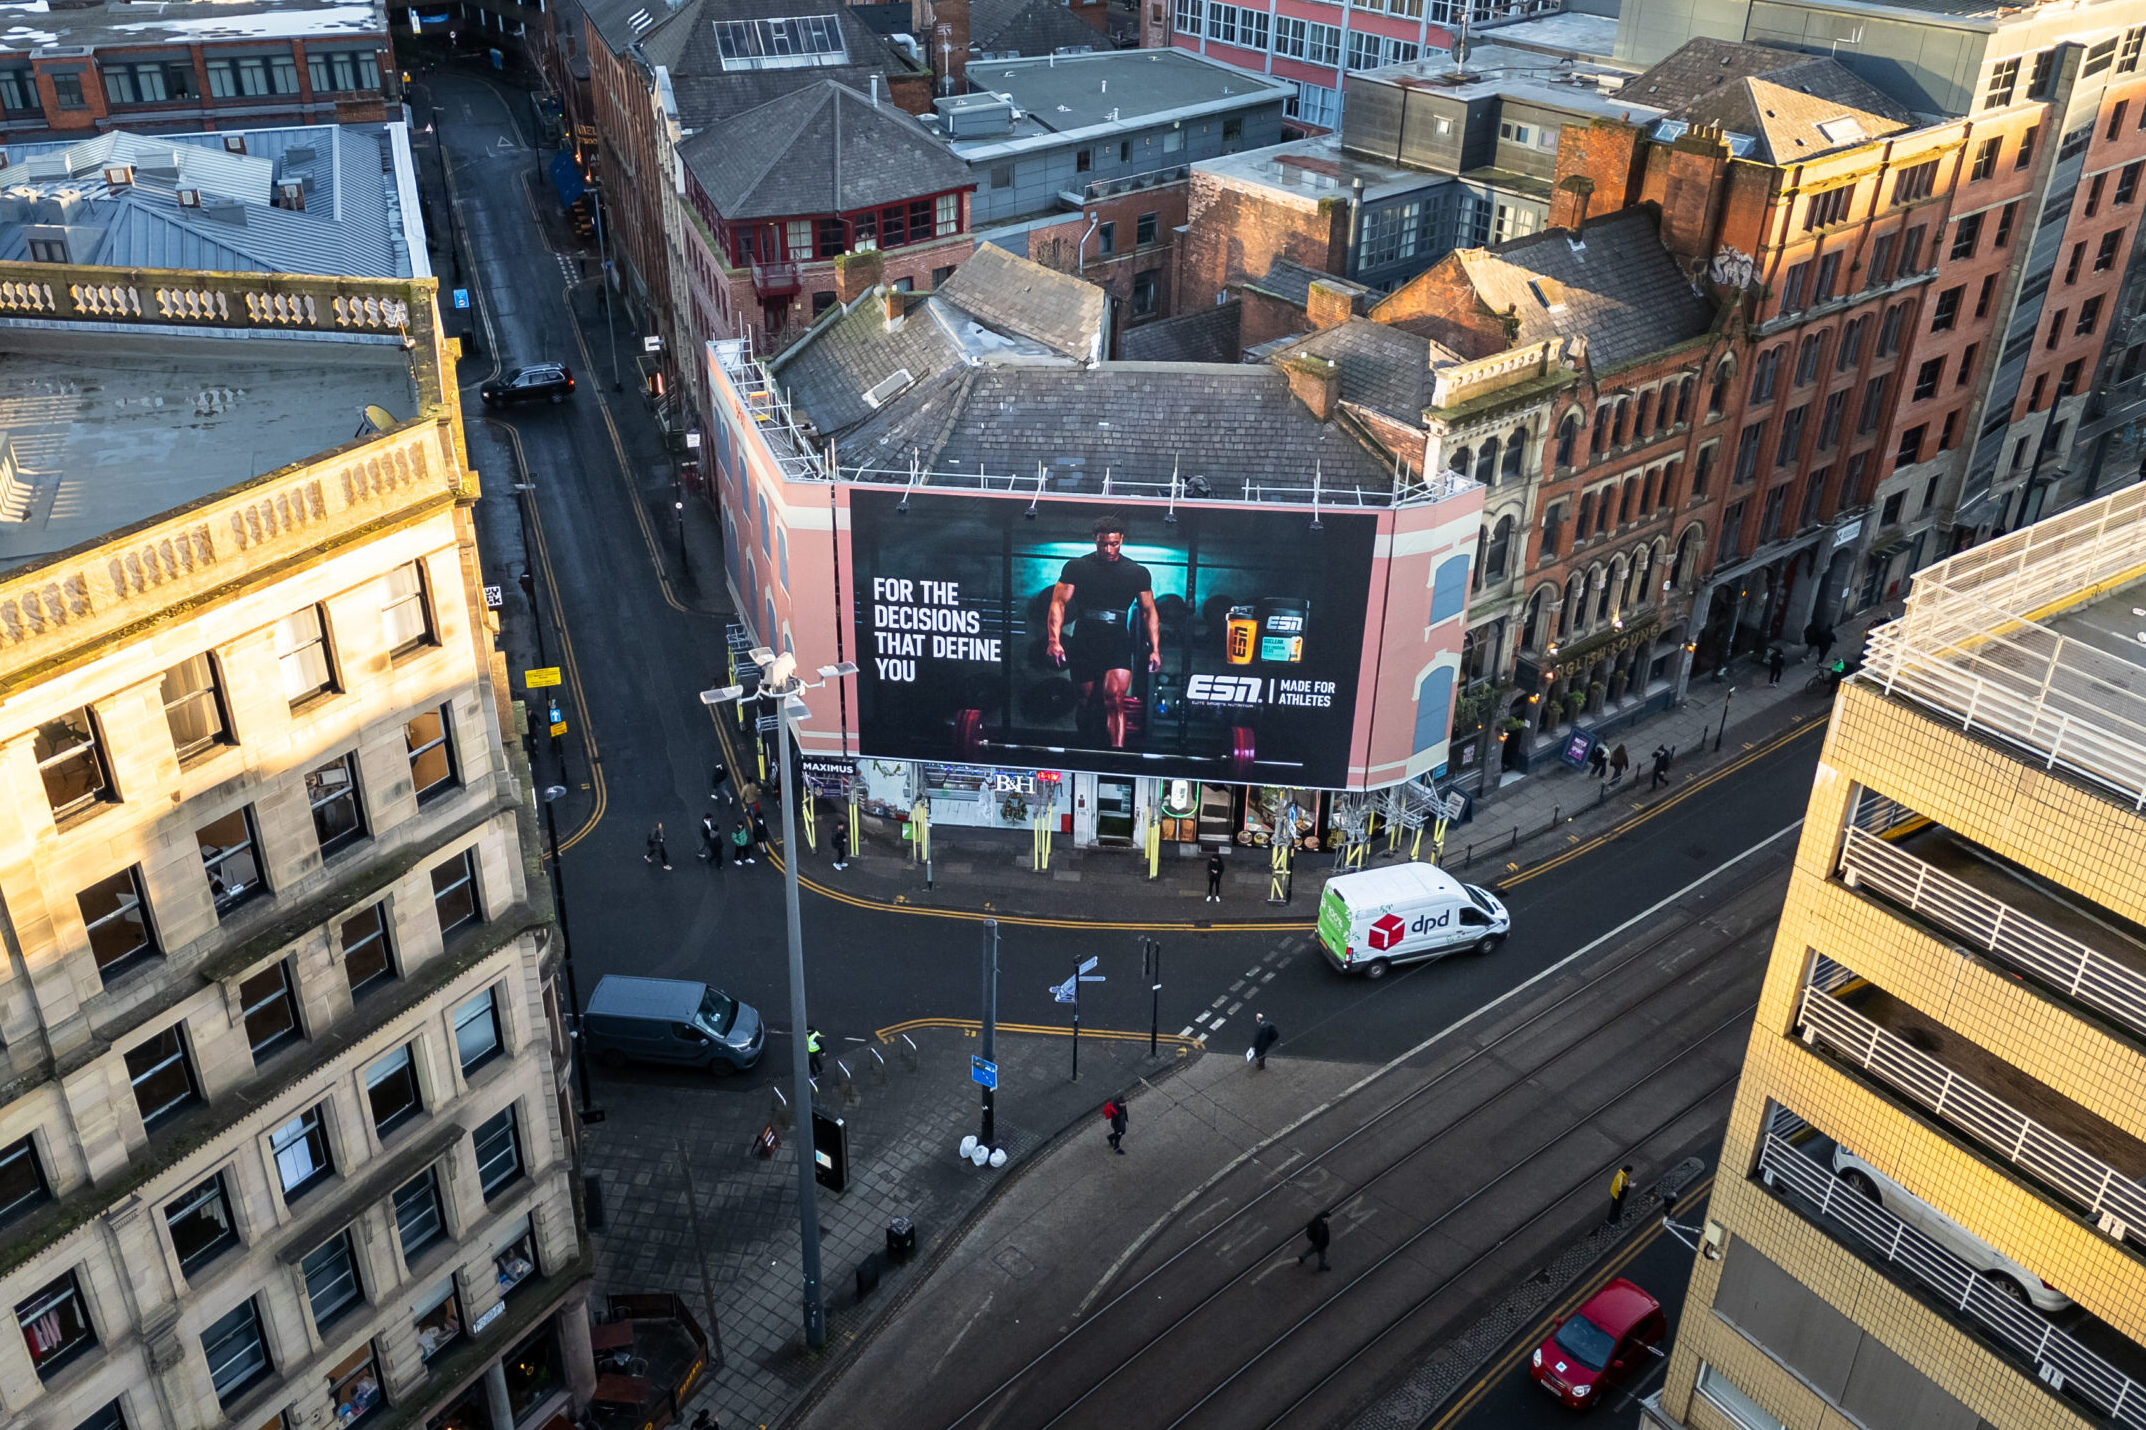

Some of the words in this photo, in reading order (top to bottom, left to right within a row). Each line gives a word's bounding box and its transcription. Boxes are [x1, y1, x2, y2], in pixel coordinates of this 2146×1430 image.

[873, 577, 914, 602] FOR
[920, 581, 959, 605] THE
[874, 605, 980, 633] DECISIONS
[1266, 615, 1303, 631] ESN
[874, 631, 926, 656] THAT
[932, 635, 1001, 661] DEFINE
[1232, 626, 1248, 657] ESN
[1554, 646, 1608, 679] NGLISH
[1610, 623, 1661, 657] LOUNG
[875, 658, 916, 682] YOU
[1186, 674, 1262, 703] ESN
[1280, 679, 1311, 692] MADE
[1314, 681, 1336, 694] FOR
[1278, 693, 1332, 707] ATHLETES
[803, 762, 854, 774] MAXIMUS
[995, 774, 1036, 794] B&H
[1411, 909, 1450, 935] dpd
